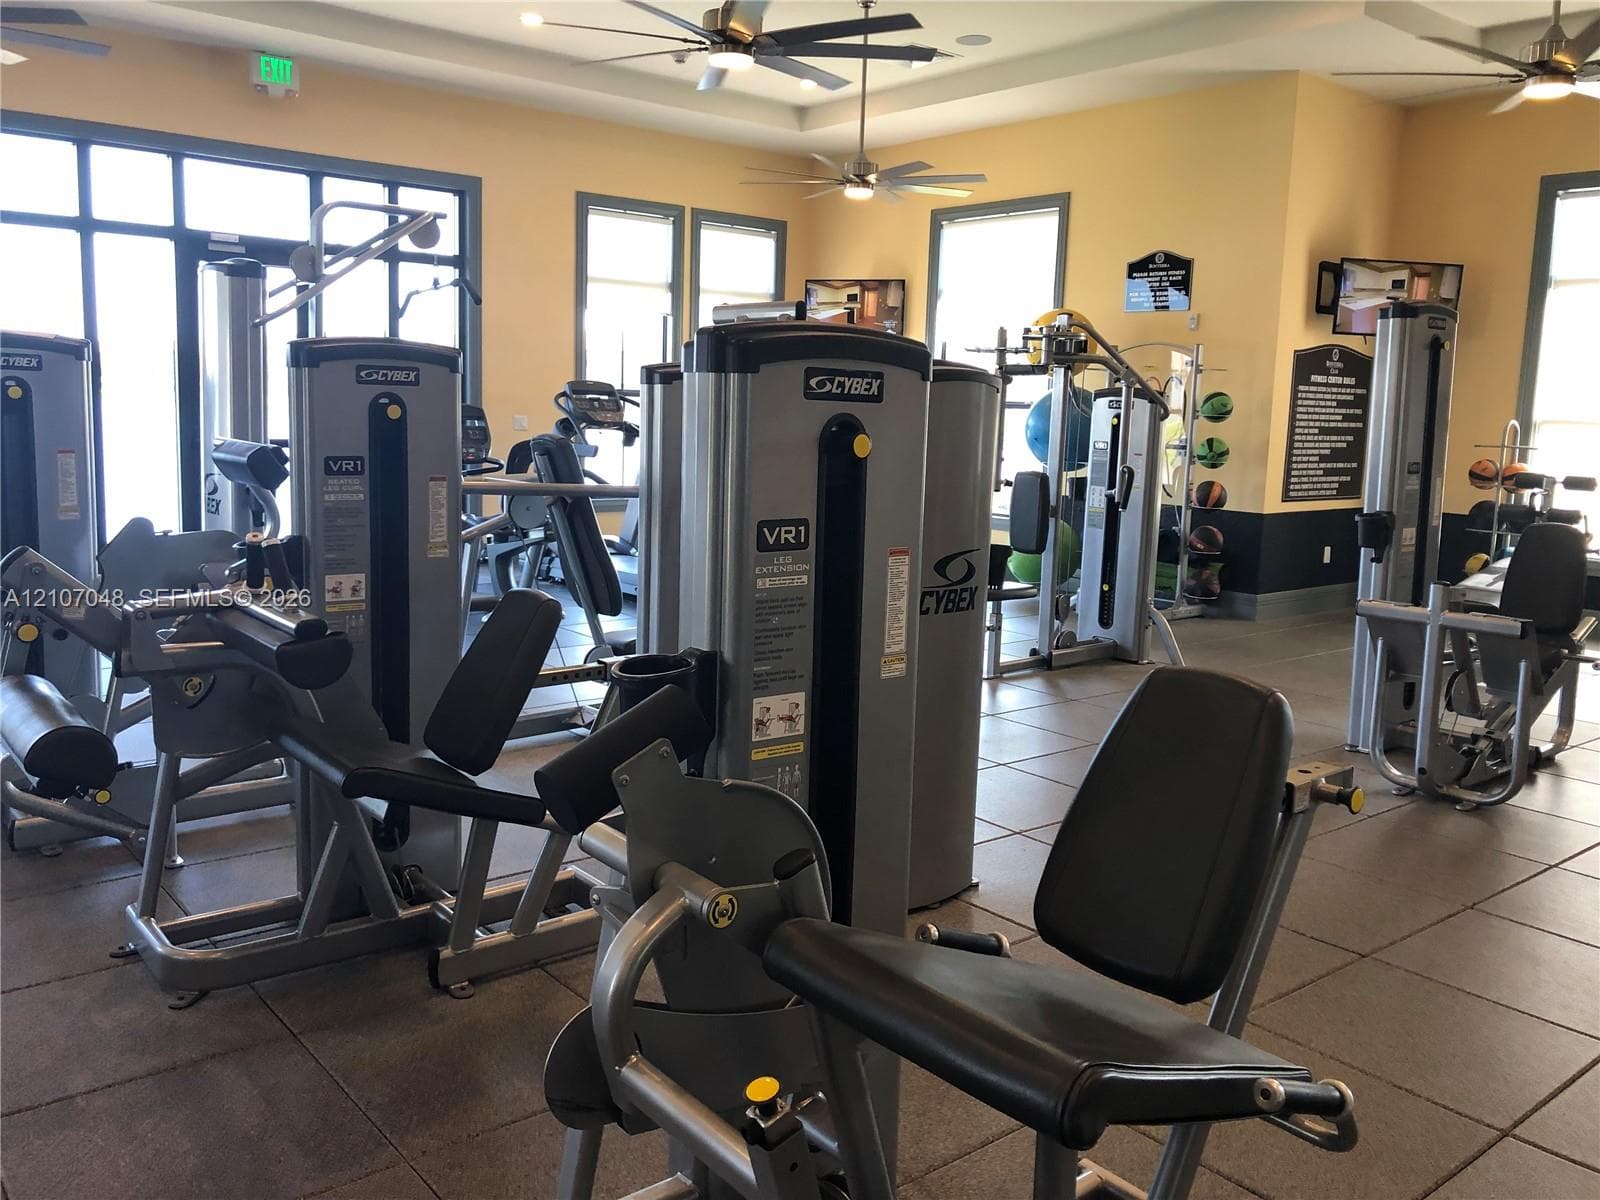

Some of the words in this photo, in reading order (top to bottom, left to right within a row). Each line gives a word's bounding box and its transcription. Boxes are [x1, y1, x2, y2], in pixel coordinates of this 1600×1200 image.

[261, 55, 292, 84] EXIT
[377, 370, 418, 384] CYBEX
[831, 377, 882, 396] CYBEX
[328, 460, 362, 472] VR1
[762, 525, 806, 545] VR1
[755, 562, 810, 574] EXTENSION
[774, 556, 792, 565] LEG
[919, 586, 979, 616] CYBEX
